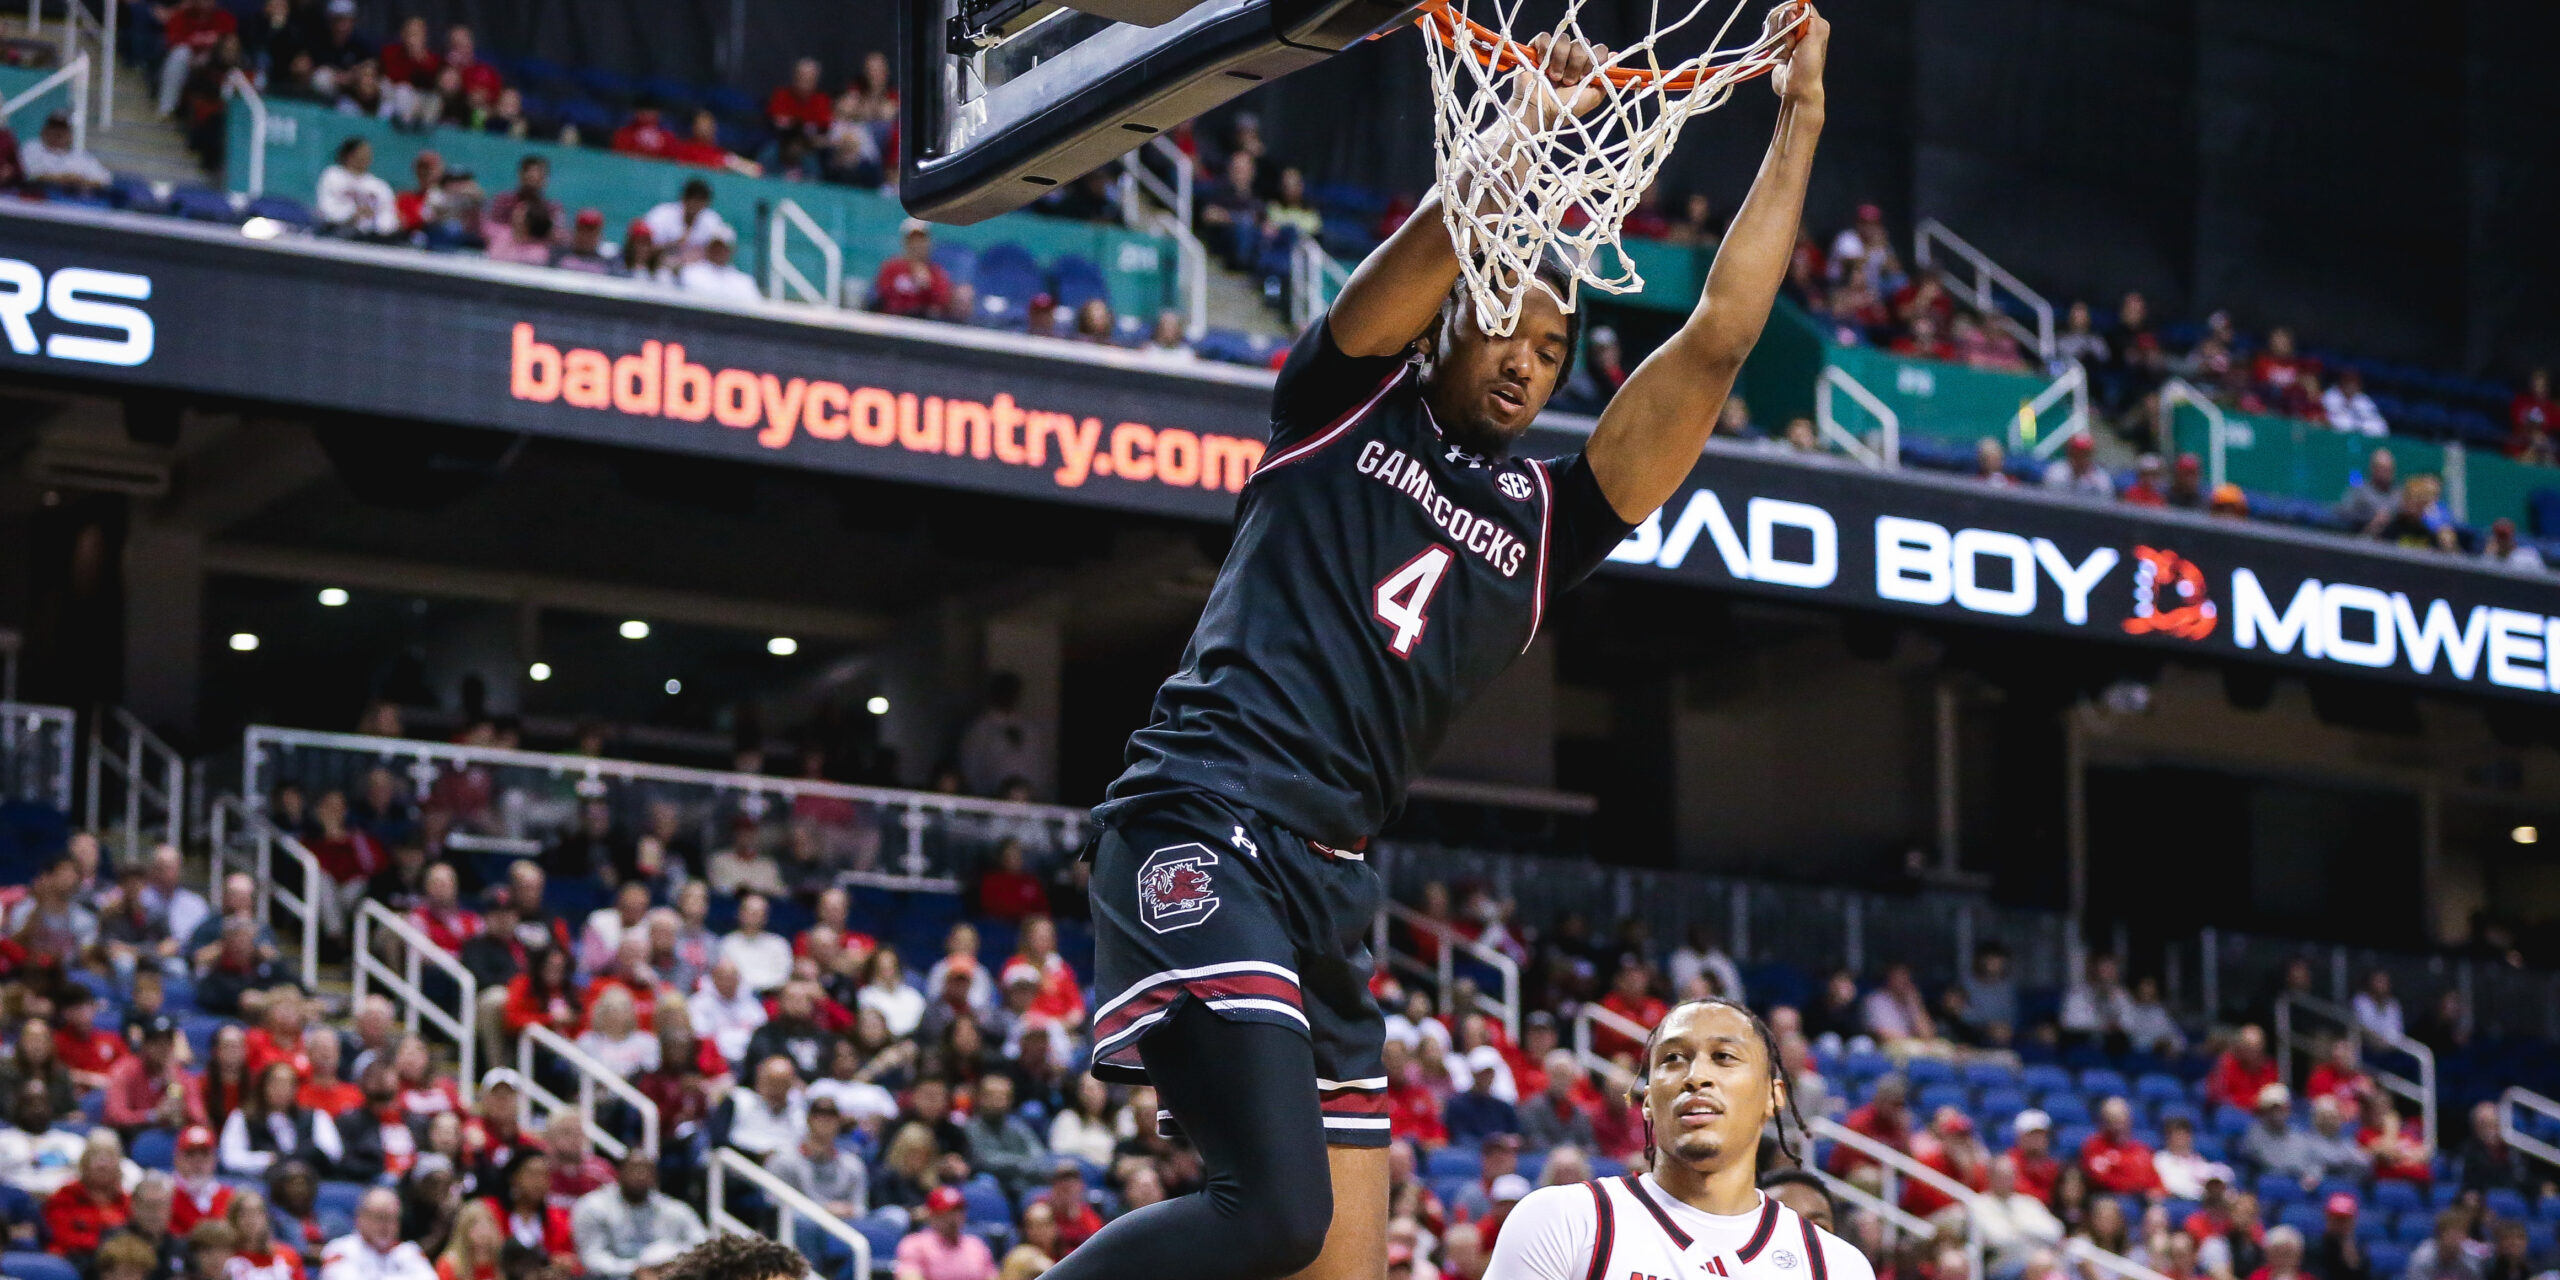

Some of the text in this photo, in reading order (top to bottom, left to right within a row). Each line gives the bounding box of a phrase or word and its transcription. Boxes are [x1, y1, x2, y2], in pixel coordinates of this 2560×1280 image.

[510, 321, 1268, 494] badboycountry.com
[1356, 440, 1526, 578] GAMECOCKS
[1498, 471, 1532, 499] SEC
[1374, 543, 1454, 659] 4
[1875, 514, 2121, 626] BOY
[2230, 566, 2560, 694] MOWE
